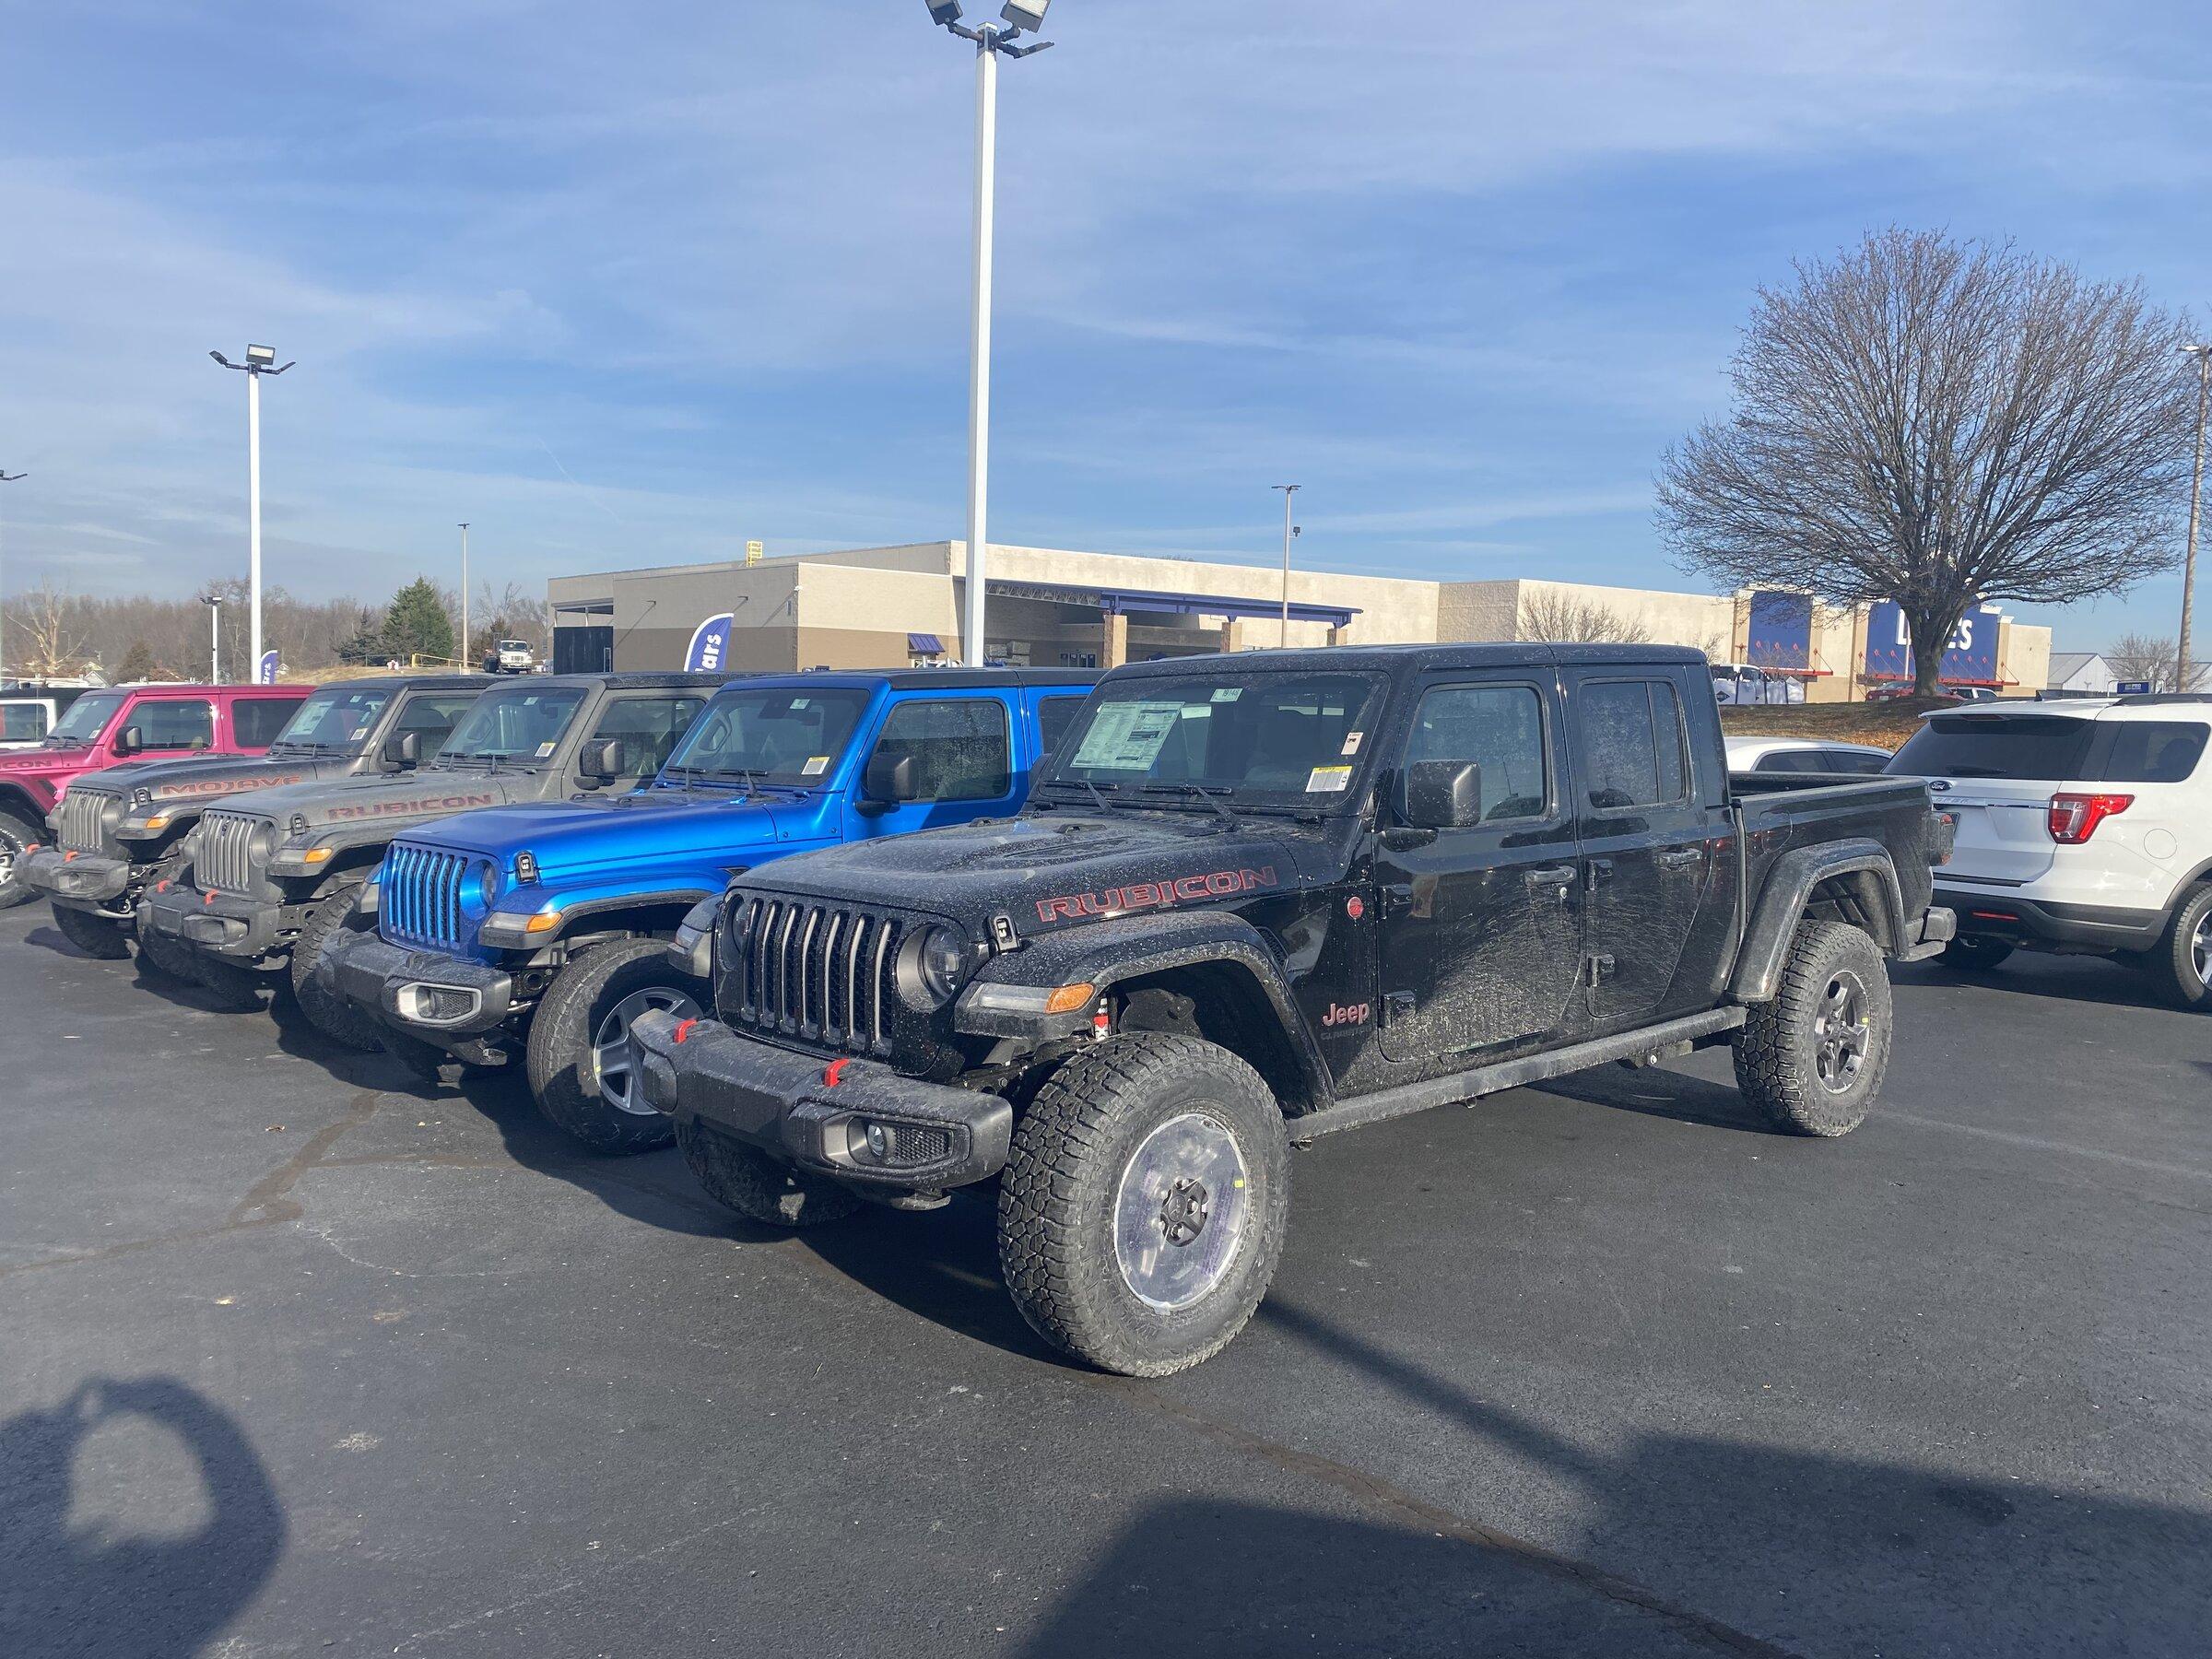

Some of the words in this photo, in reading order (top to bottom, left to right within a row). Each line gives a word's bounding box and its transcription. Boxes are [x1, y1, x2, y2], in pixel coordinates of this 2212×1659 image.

[695, 634, 722, 671] ars
[327, 794, 491, 820] RUBICON
[1036, 866, 1277, 922] RUBICON
[1323, 1003, 1370, 1027] Jeep
